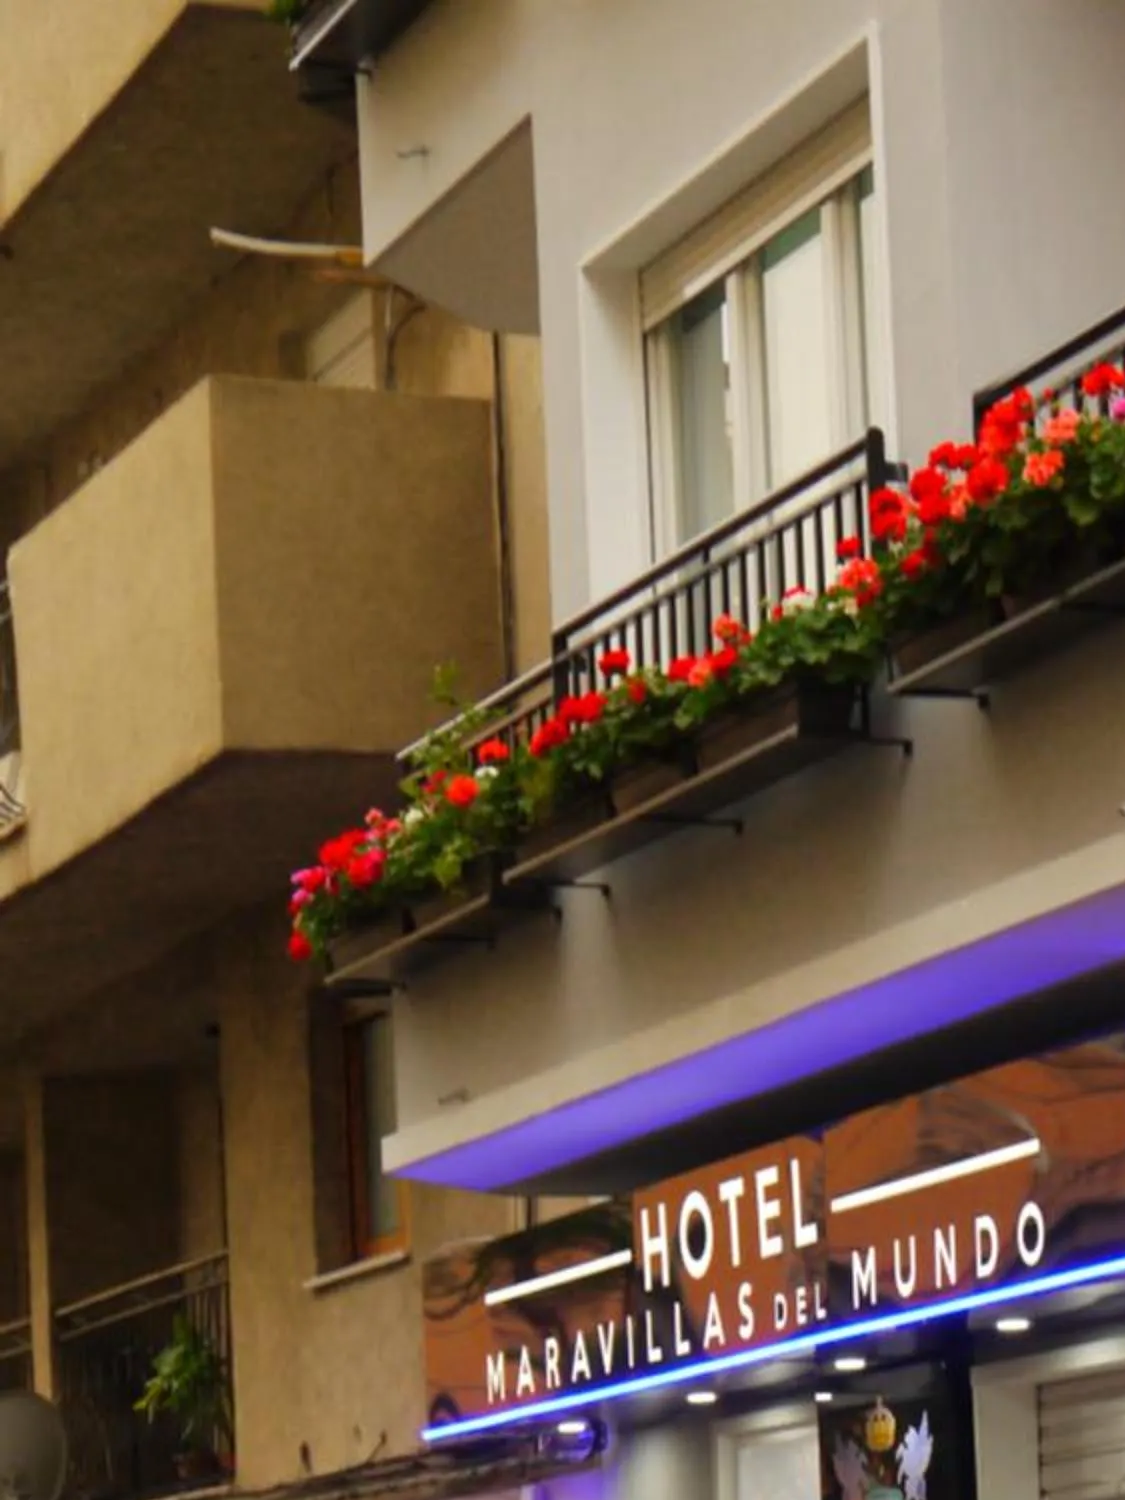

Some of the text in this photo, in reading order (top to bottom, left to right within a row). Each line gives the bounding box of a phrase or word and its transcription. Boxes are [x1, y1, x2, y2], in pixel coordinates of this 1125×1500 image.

[486, 1201, 1045, 1404] MARAVILLAS DEL MUNDO
[641, 1158, 818, 1292] HOTEL
